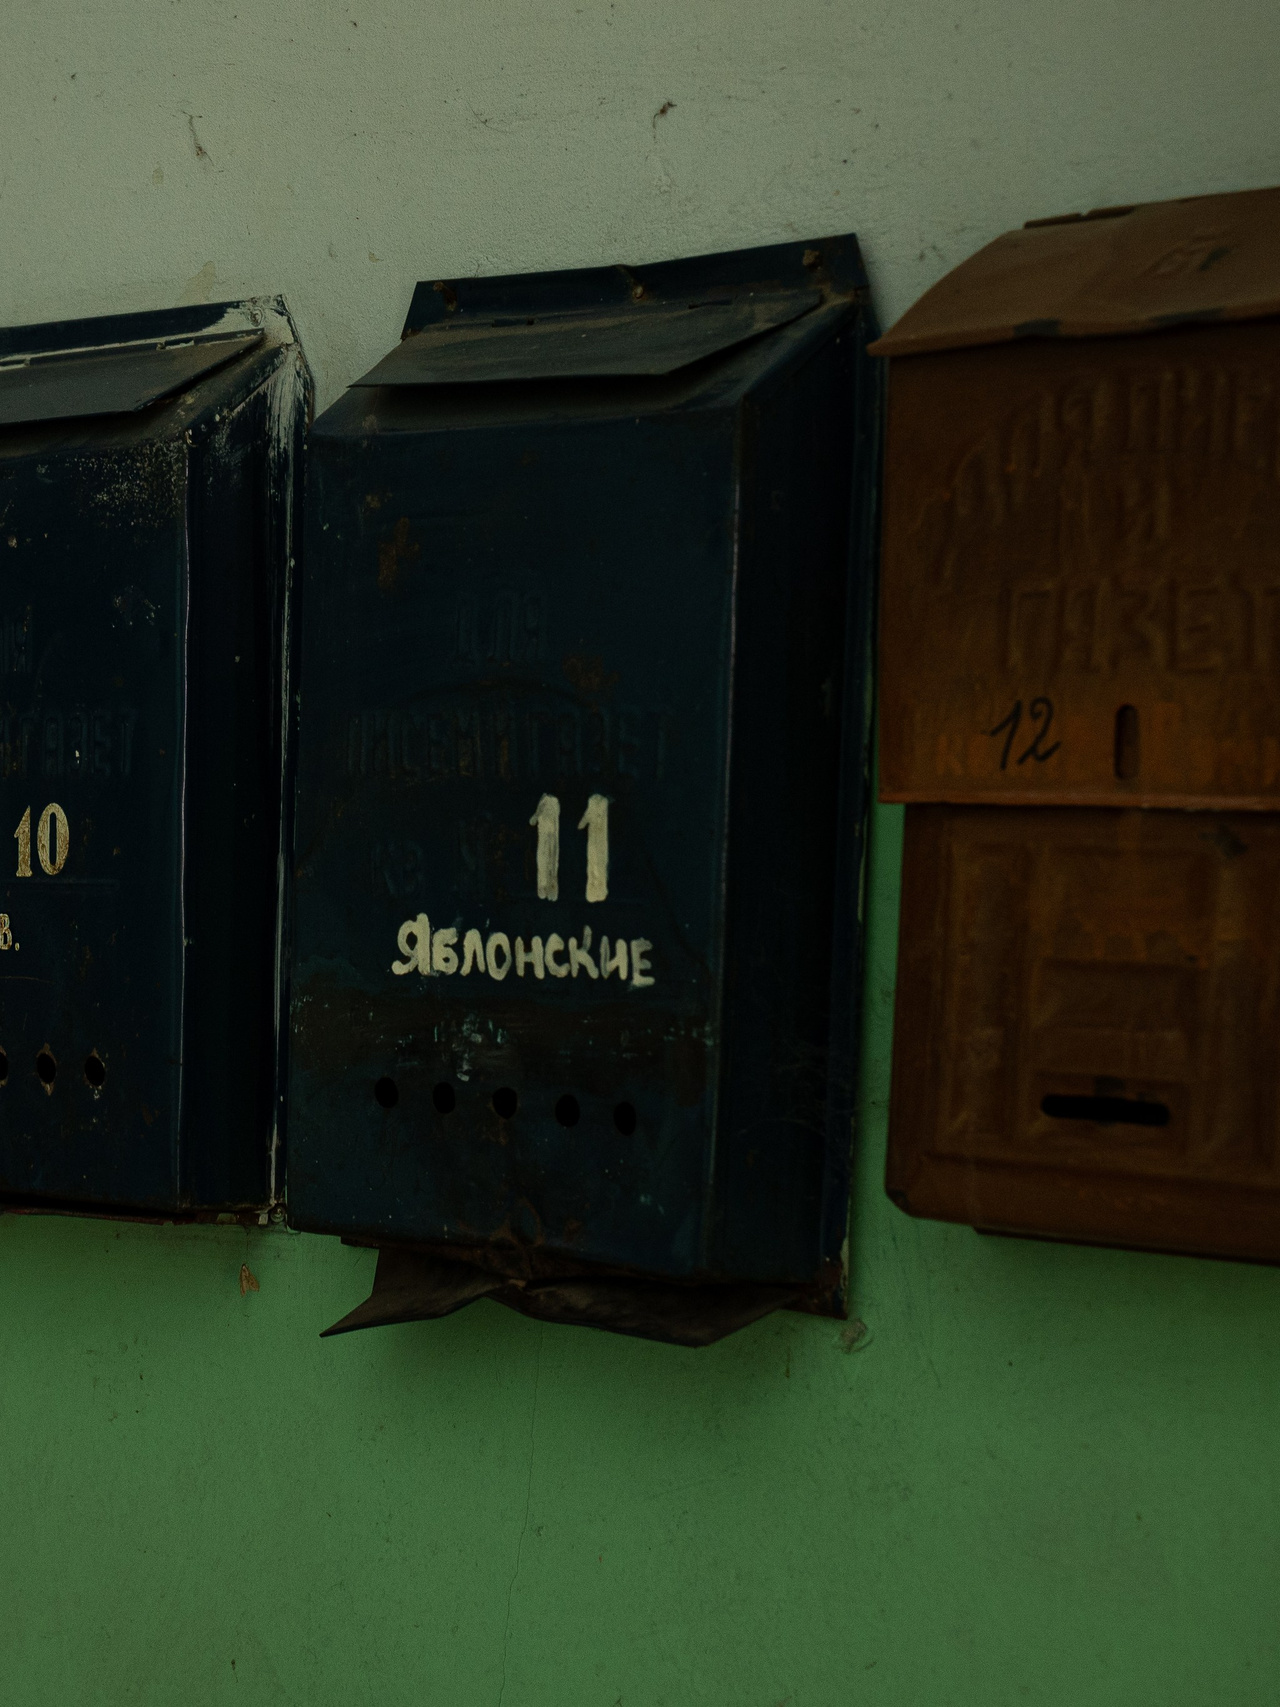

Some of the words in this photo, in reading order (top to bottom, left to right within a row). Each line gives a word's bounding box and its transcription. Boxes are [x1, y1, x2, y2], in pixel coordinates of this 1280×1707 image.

[984, 696, 1062, 771] 12
[13, 801, 71, 879] 10
[529, 791, 614, 903] 11
